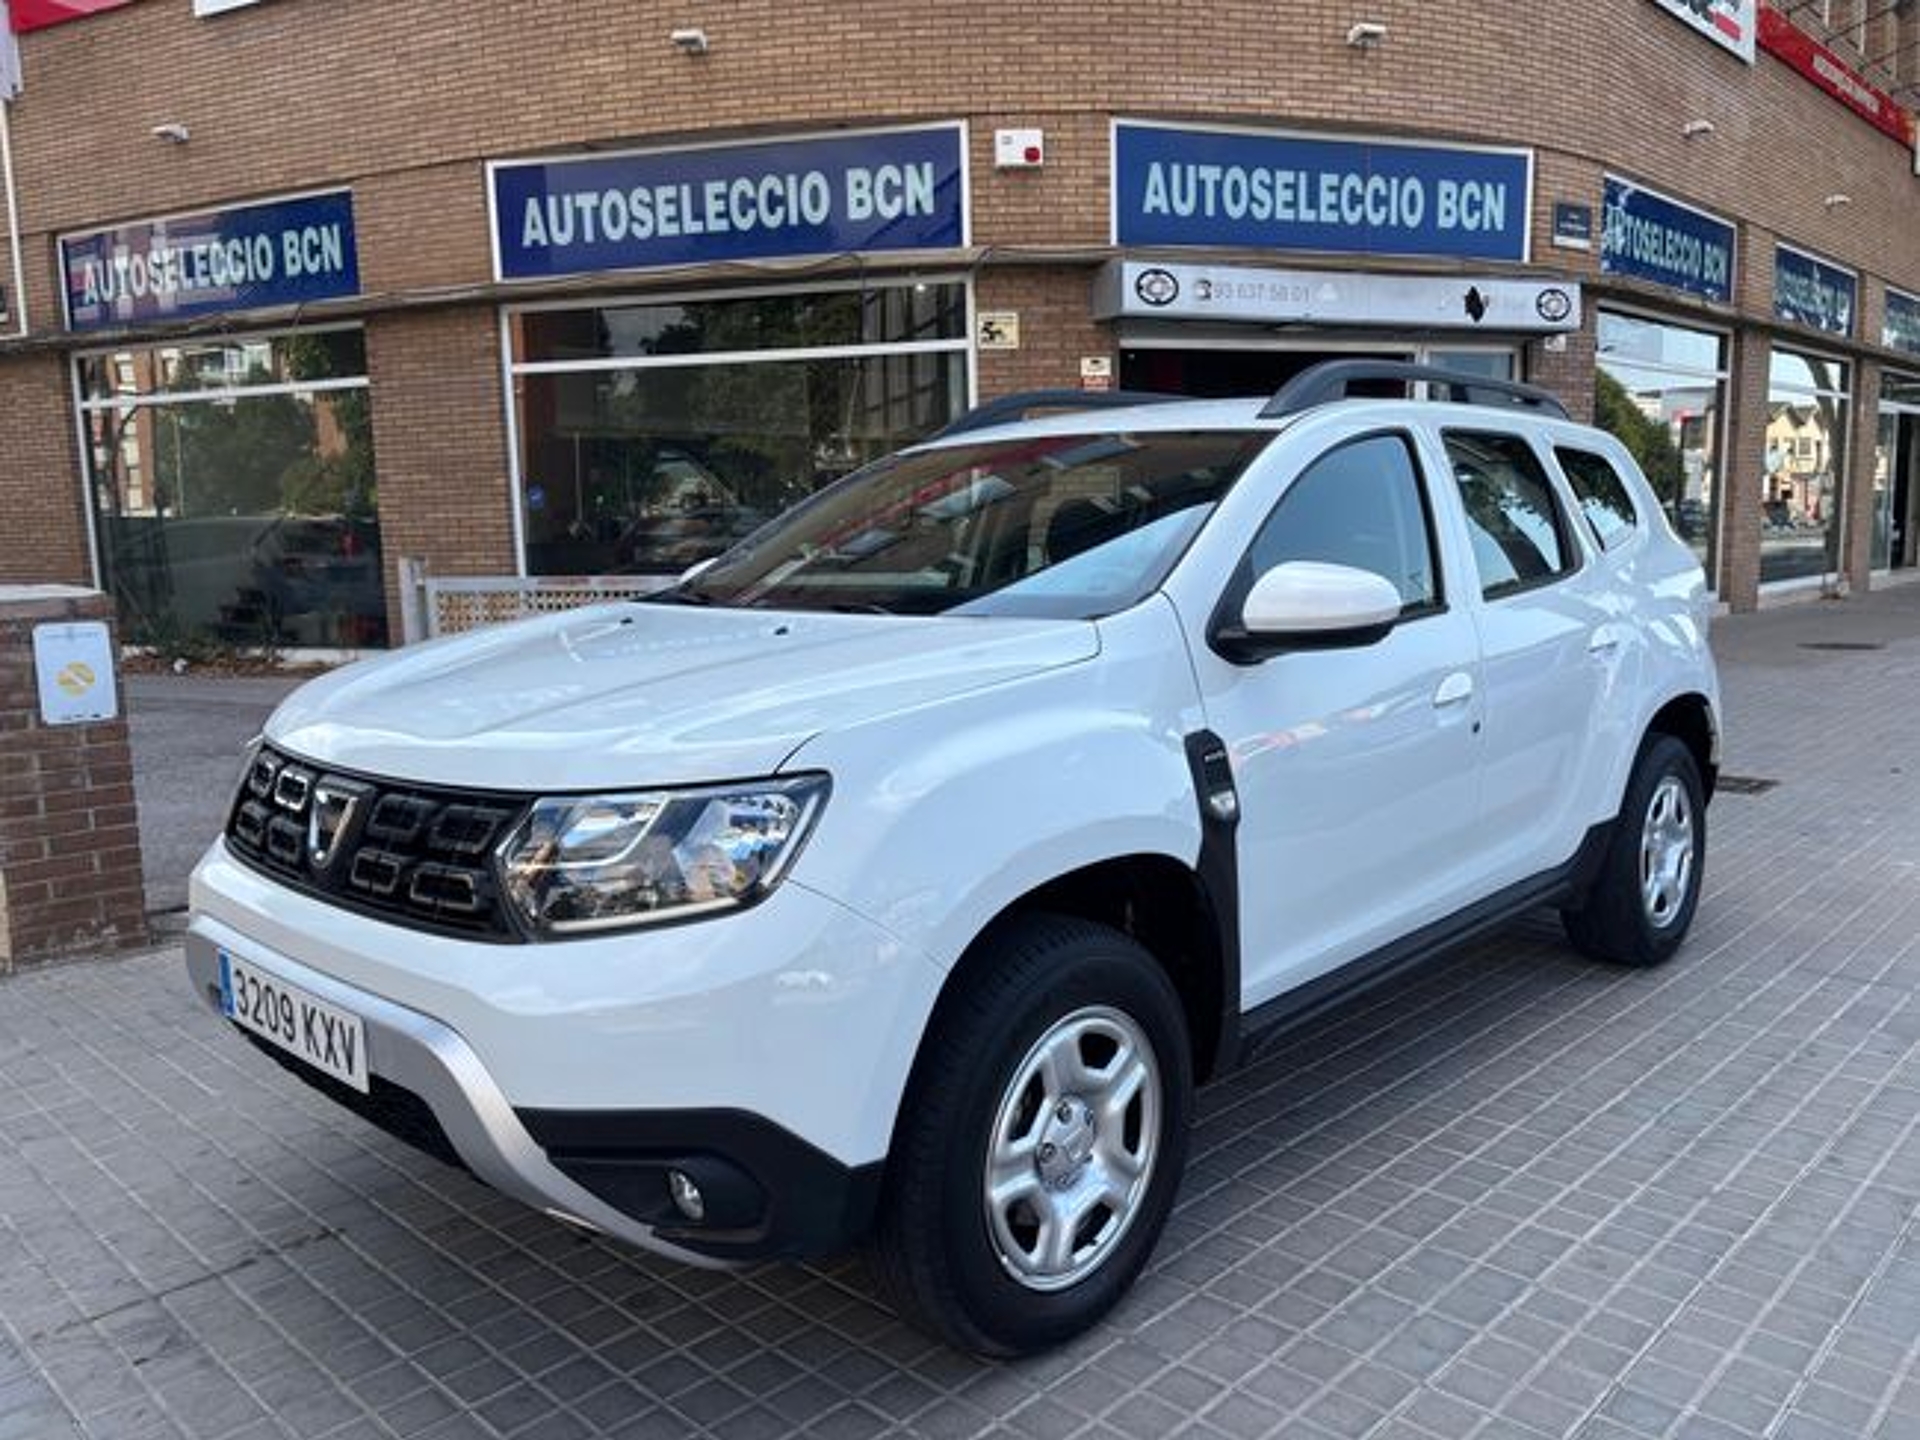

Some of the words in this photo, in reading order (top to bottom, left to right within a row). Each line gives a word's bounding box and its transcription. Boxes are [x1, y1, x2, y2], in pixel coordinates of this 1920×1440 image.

[521, 170, 830, 248] AUTOSELECCIO
[845, 161, 936, 221] BCN
[1142, 161, 1425, 230] AUTOSELECCIO
[1436, 179, 1505, 231] BCN
[83, 232, 274, 305] AUTOSELECCIO
[282, 223, 343, 277] BCN
[235, 968, 296, 1043] 3209
[301, 1003, 355, 1076] KXV
